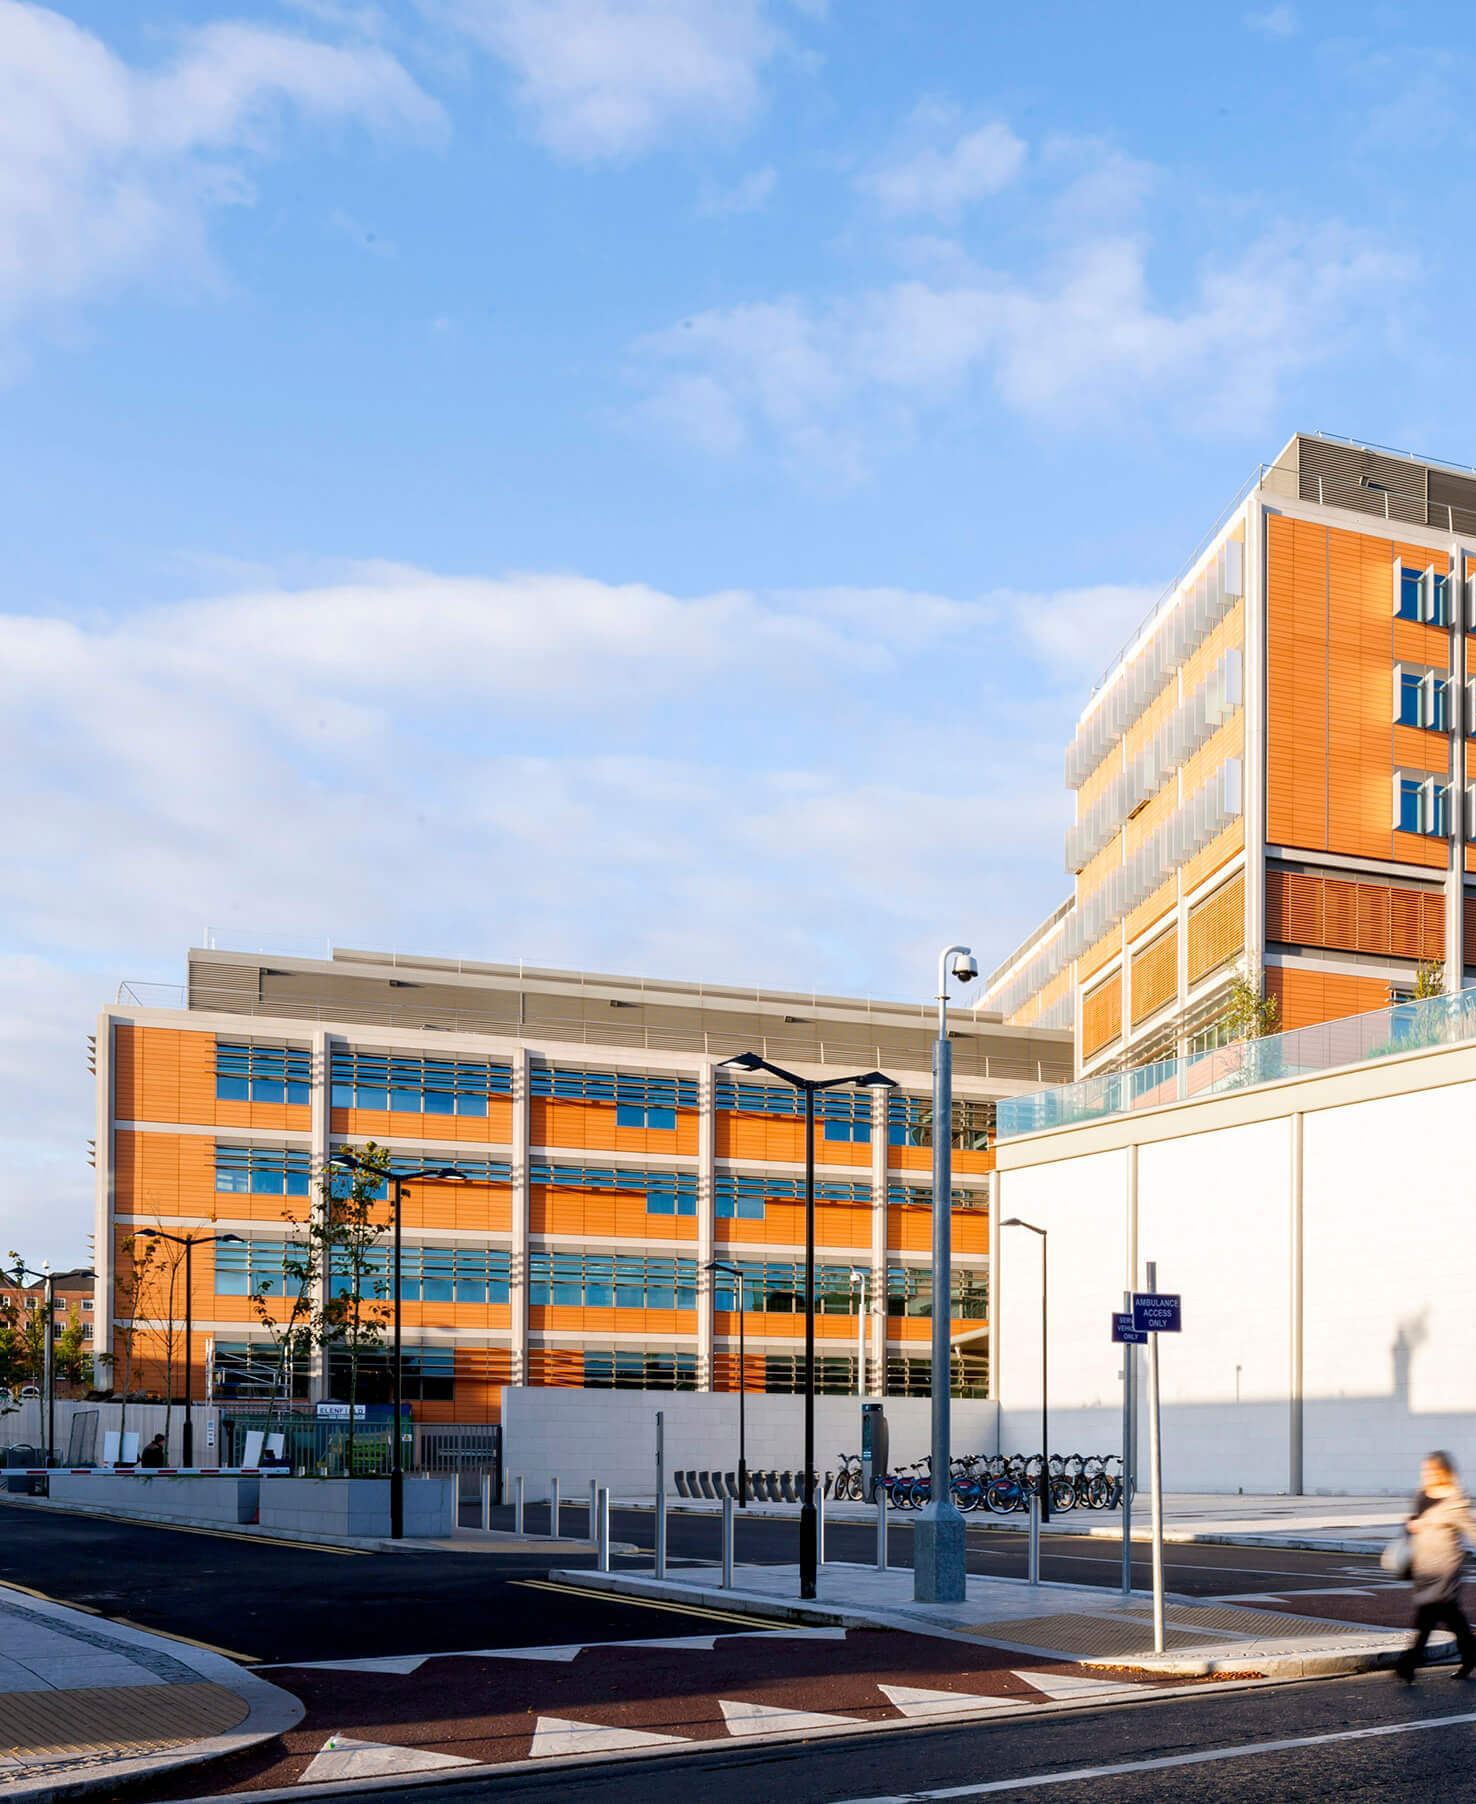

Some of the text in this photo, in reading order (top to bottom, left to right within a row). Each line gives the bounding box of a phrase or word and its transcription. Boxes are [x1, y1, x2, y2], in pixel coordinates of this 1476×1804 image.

[1135, 1298, 1179, 1307] AMBULANCE
[1143, 1309, 1172, 1318] ACCESS
[1148, 1319, 1168, 1328] ONLY
[1122, 1332, 1140, 1340] ONLY
